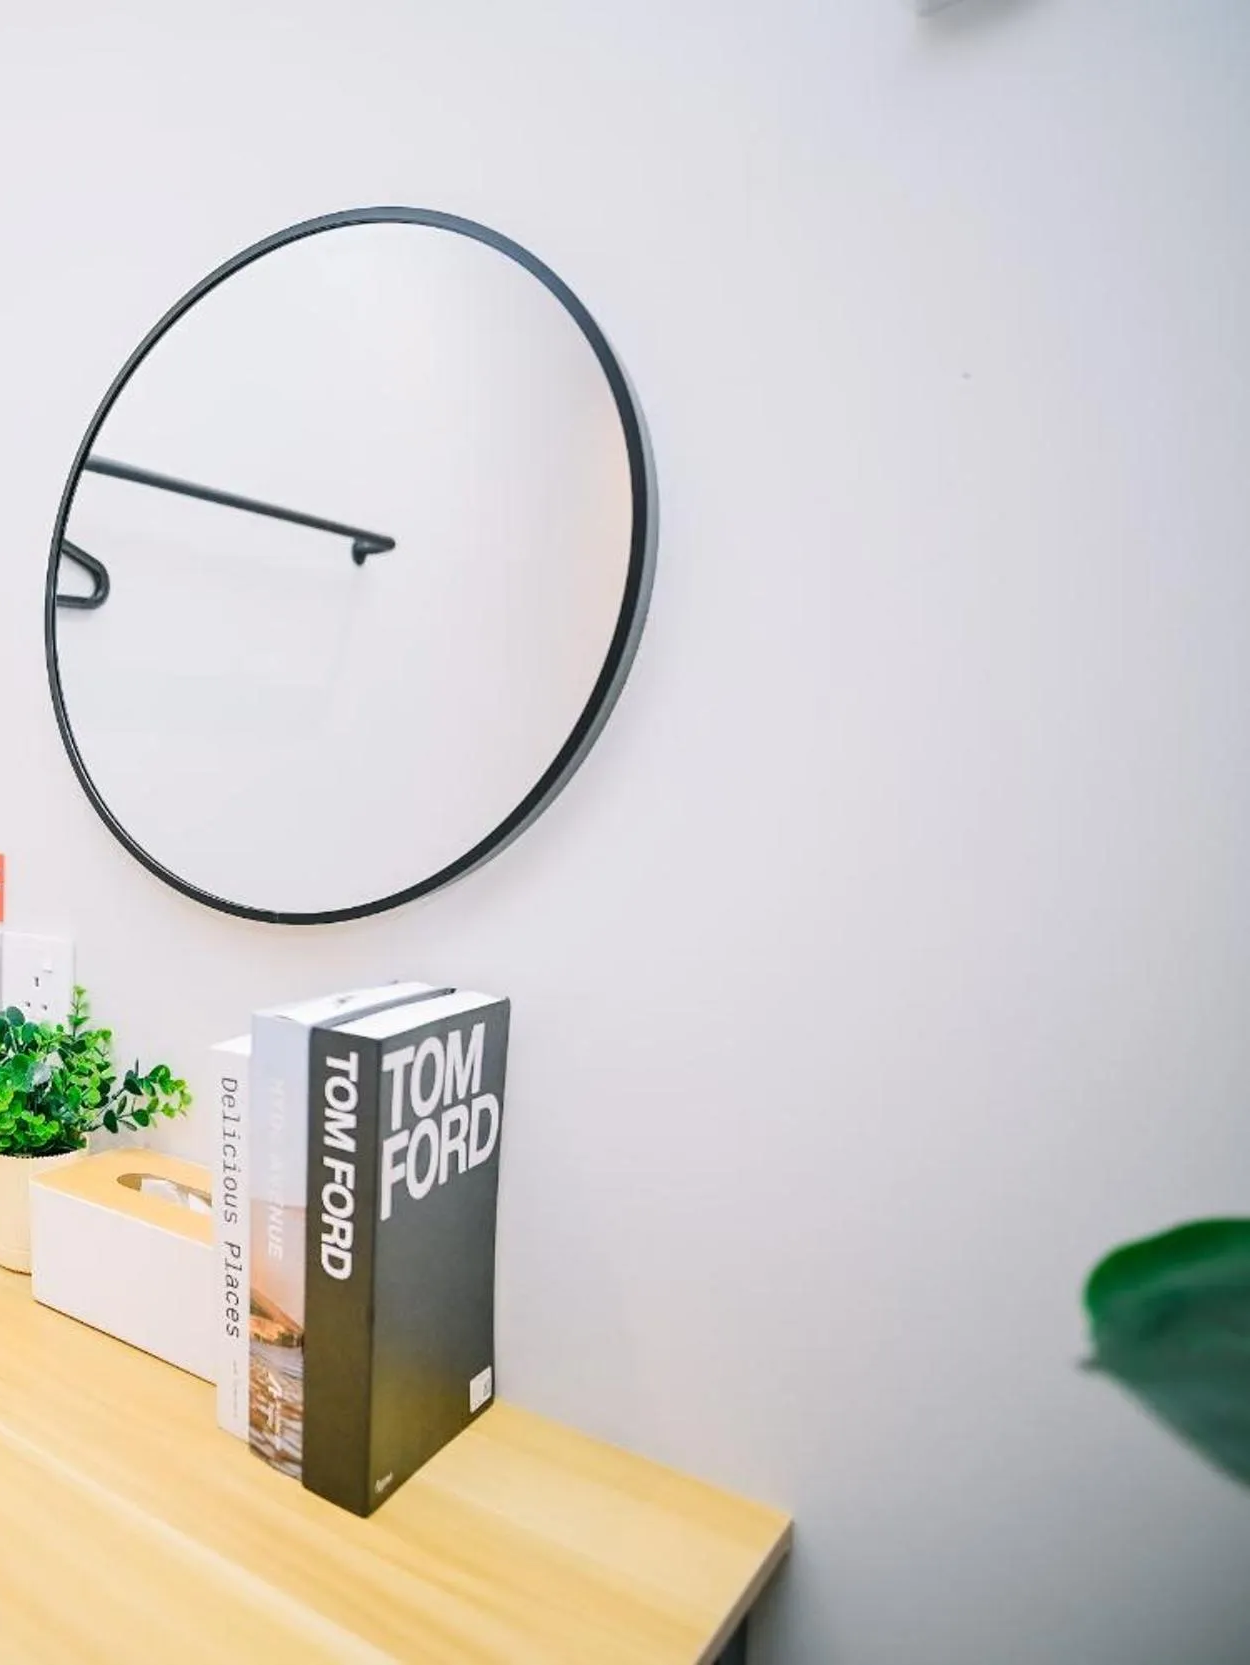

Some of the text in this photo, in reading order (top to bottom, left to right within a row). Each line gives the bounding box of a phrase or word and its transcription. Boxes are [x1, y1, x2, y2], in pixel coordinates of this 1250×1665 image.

[381, 1023, 486, 1132] TOM
[221, 1077, 241, 1224] Delicious
[321, 1051, 359, 1281] TOM FORD
[380, 1093, 499, 1221] FORD
[223, 1241, 243, 1338] Places
